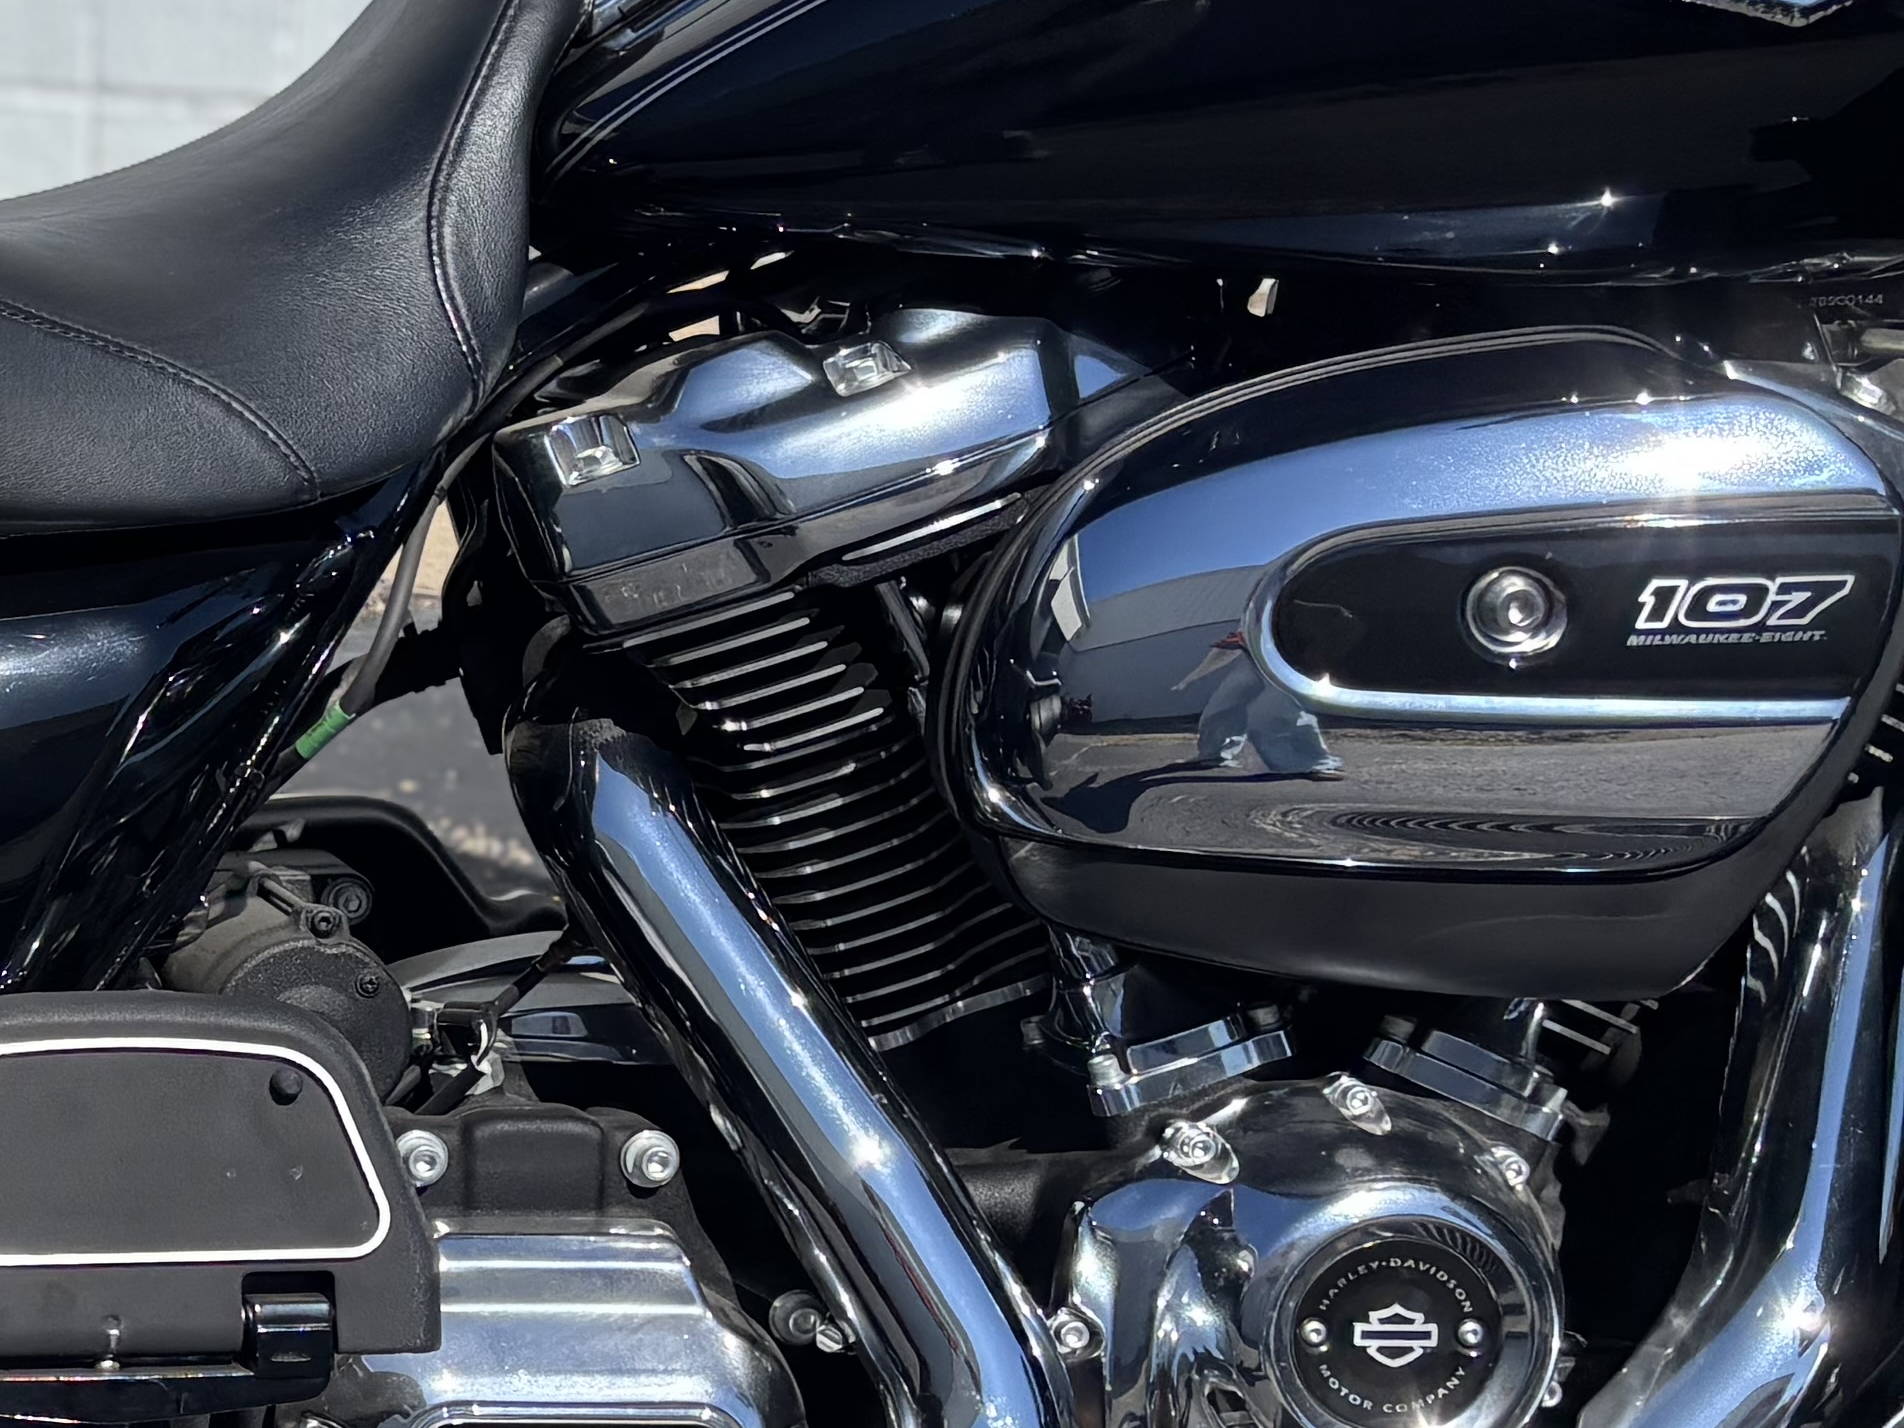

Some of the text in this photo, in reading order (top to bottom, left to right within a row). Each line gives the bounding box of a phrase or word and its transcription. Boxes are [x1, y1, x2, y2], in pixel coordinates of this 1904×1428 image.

[1635, 575, 1855, 629] 107
[1319, 1364, 1465, 1413] MOTOR COMPANY
